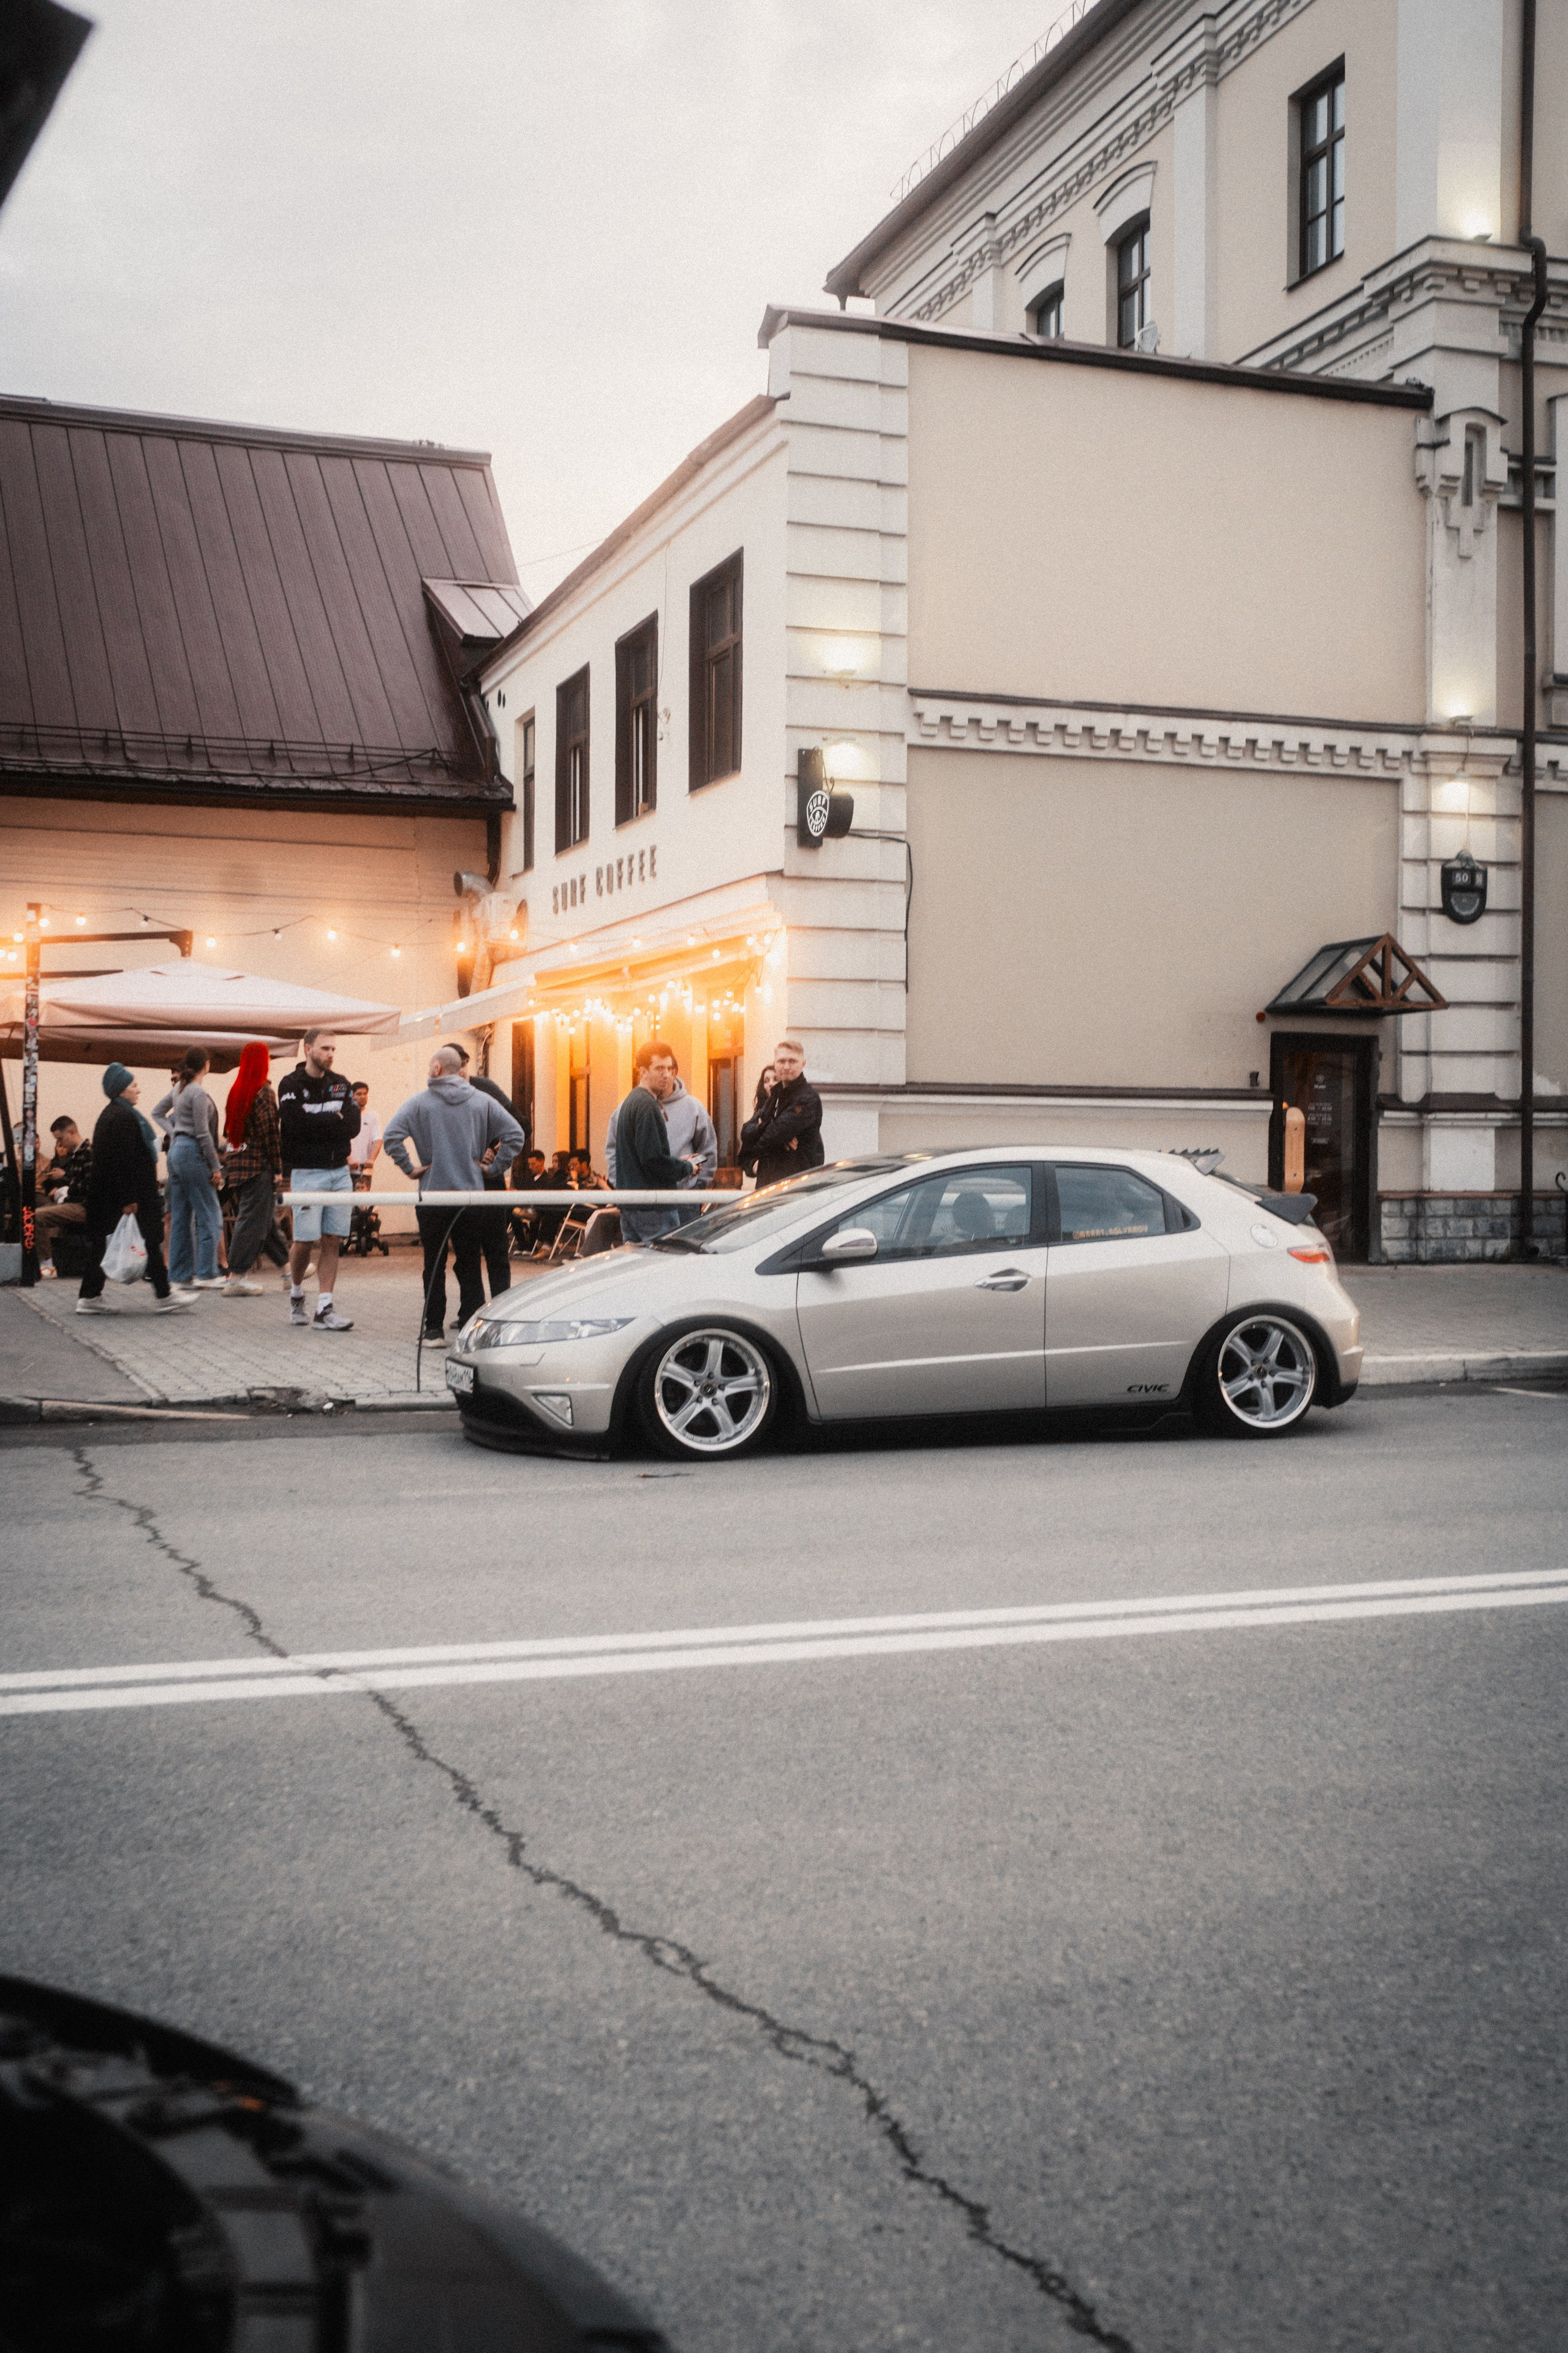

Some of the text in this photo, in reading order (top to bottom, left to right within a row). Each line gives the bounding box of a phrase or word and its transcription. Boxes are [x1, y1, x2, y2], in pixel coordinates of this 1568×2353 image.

[809, 795, 826, 813] SURF
[595, 844, 657, 897] COFFEE
[1127, 1384, 1169, 1393] CIVIC
